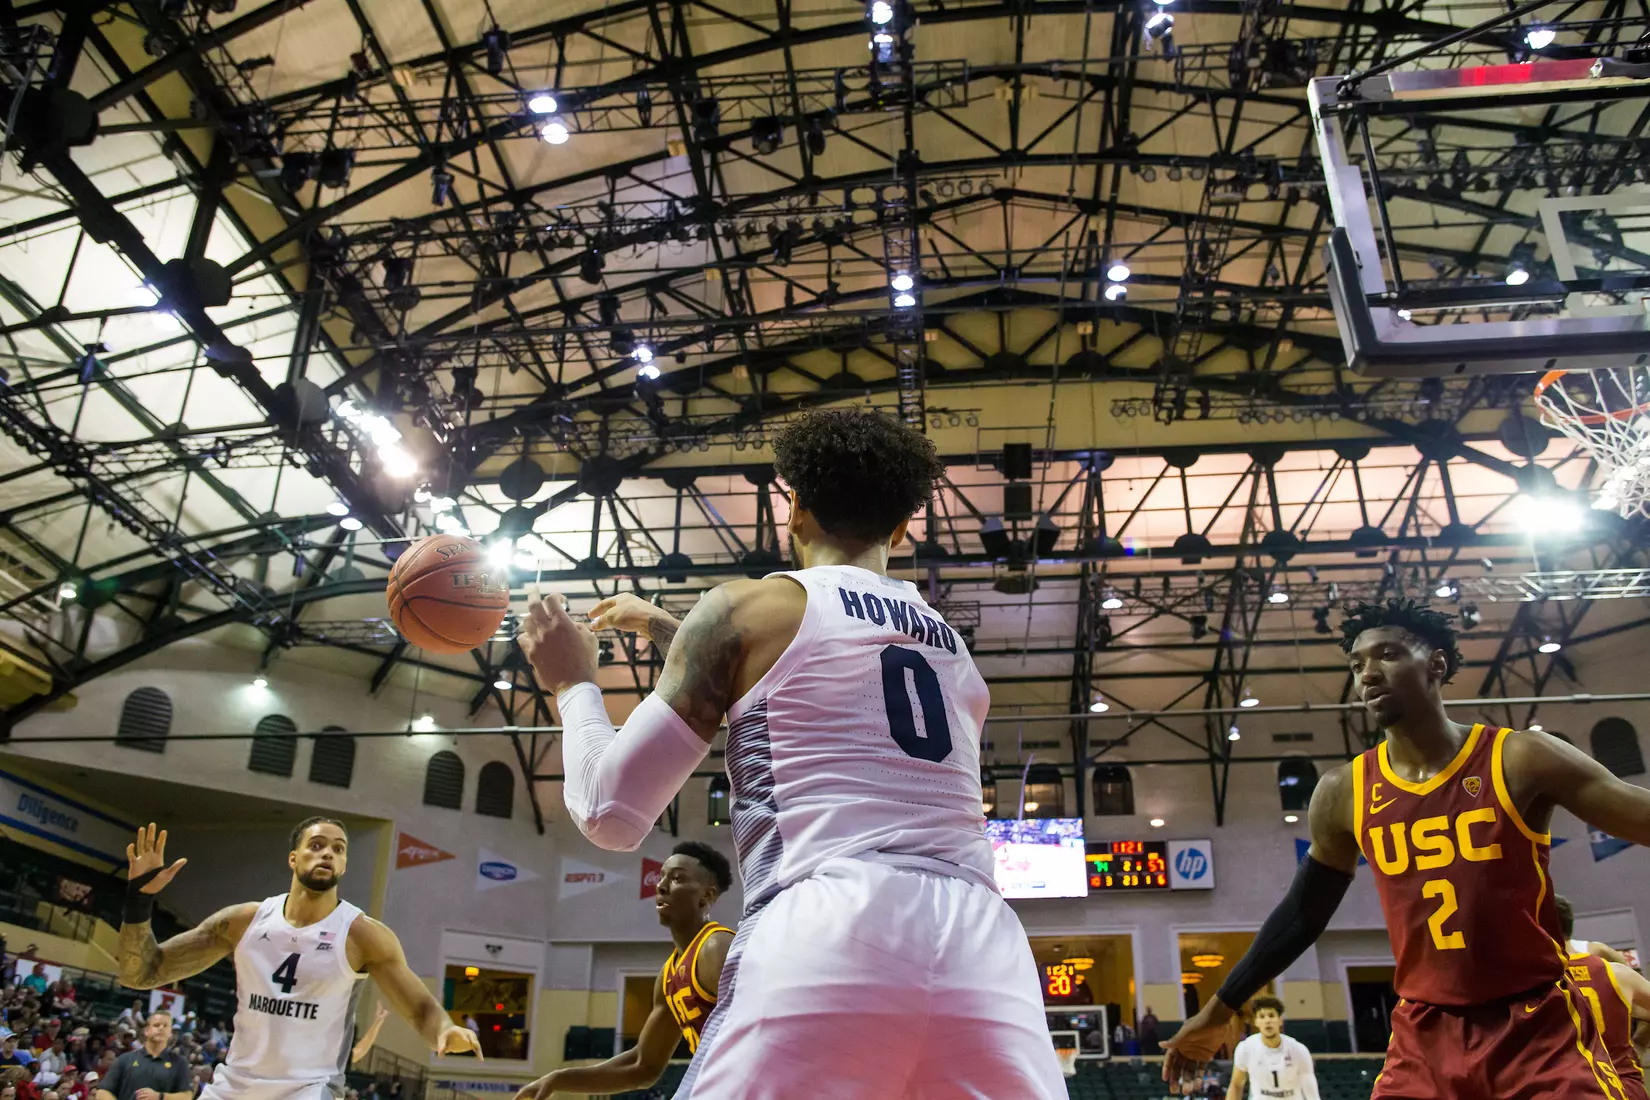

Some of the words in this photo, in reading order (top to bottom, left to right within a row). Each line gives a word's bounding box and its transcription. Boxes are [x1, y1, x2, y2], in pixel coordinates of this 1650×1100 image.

[838, 587, 958, 655] HOWARD
[880, 644, 953, 763] 0
[1371, 783, 1383, 802] C
[17, 793, 79, 833] Diligence
[1369, 807, 1503, 876] USC
[1179, 848, 1204, 881] hp
[1421, 878, 1467, 951] 2
[272, 952, 301, 994] 4
[1048, 975, 1072, 996] 20
[248, 993, 319, 1020] MARQUETTE
[1271, 1070, 1279, 1088] 1
